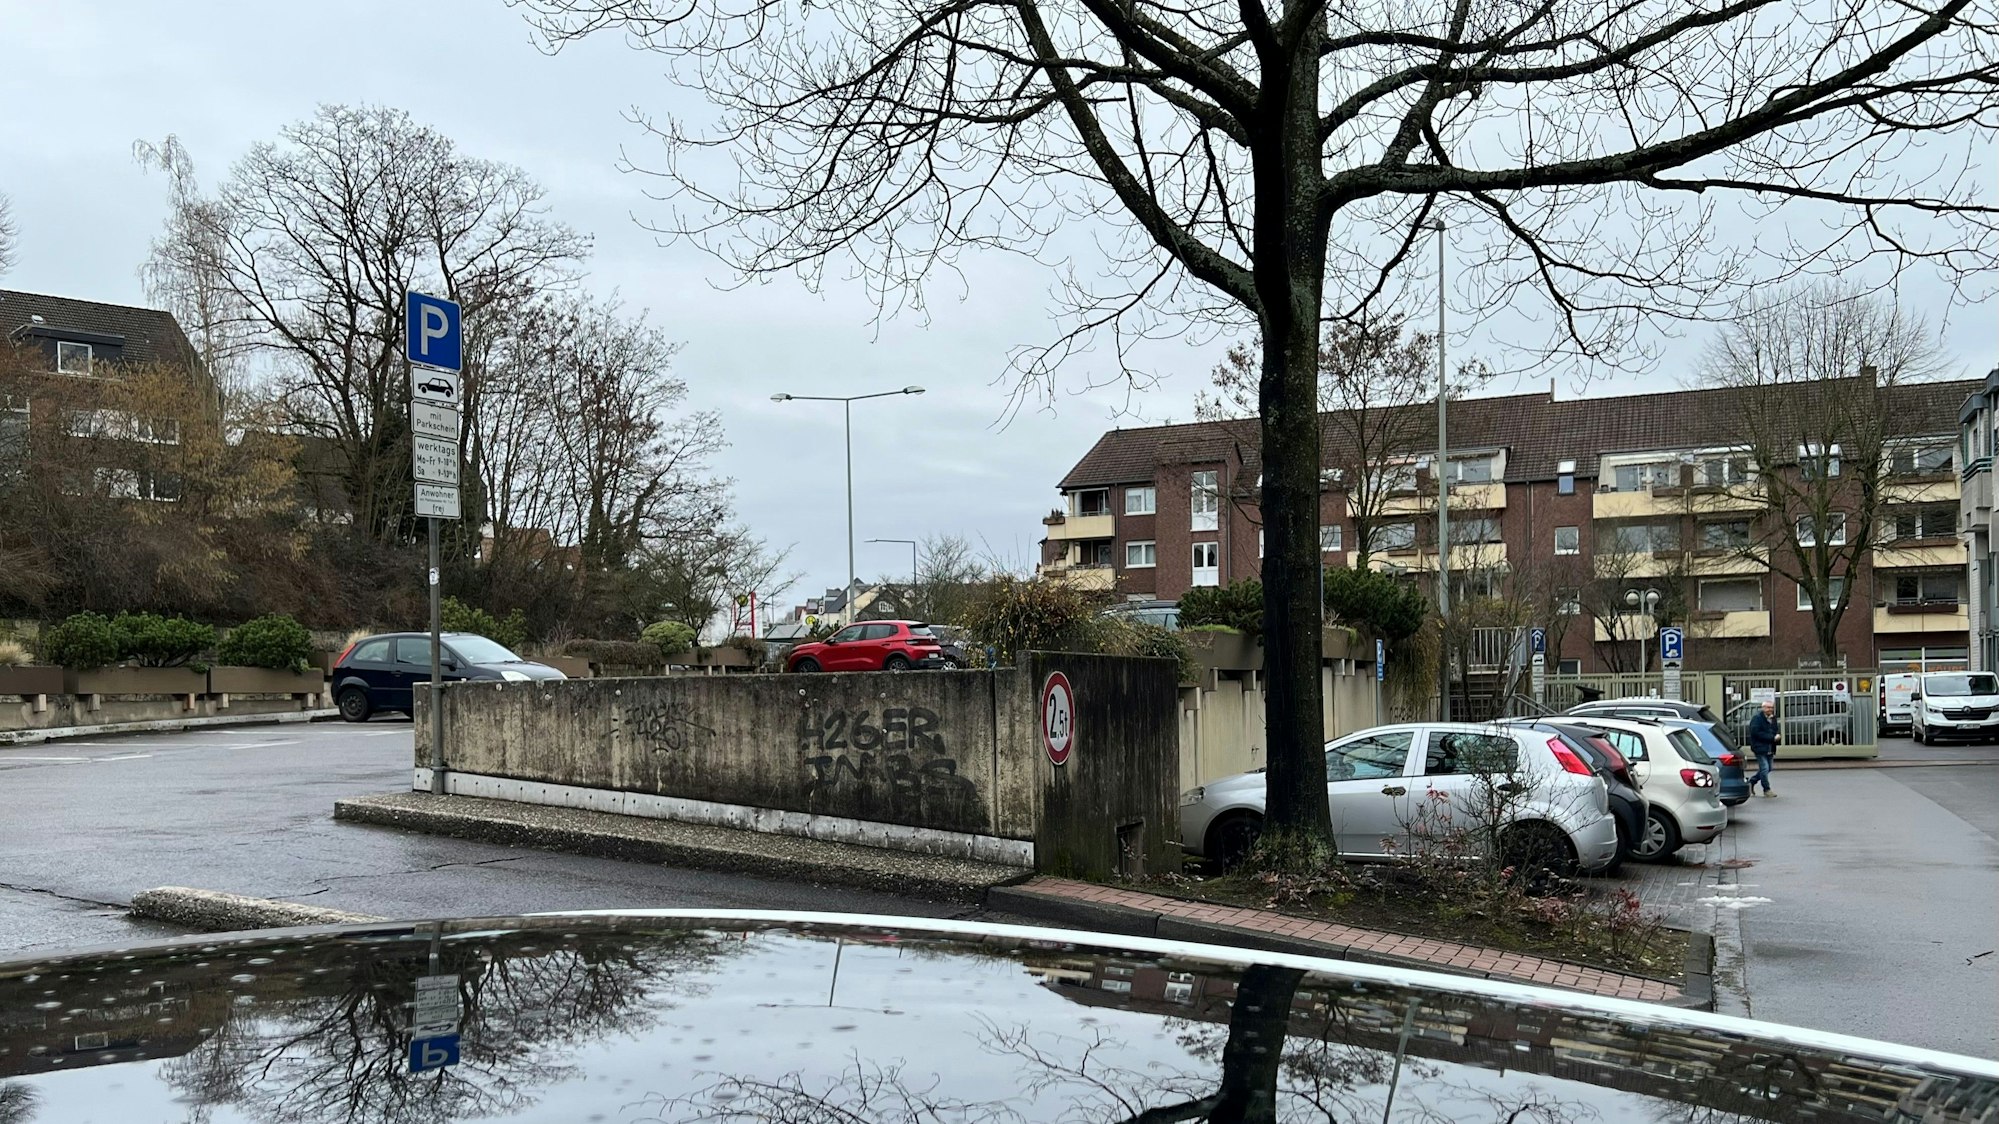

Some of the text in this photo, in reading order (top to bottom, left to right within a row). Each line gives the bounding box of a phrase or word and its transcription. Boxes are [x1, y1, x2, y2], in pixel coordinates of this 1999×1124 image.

[420, 303, 449, 355] P
[430, 412, 442, 421] mit
[416, 418, 456, 434] Parkschein
[417, 442, 456, 457] werktags
[417, 465, 425, 476] Sa
[420, 488, 455, 500] Anwohner
[1665, 633, 1678, 652] P
[1049, 692, 1069, 740] 2,5t
